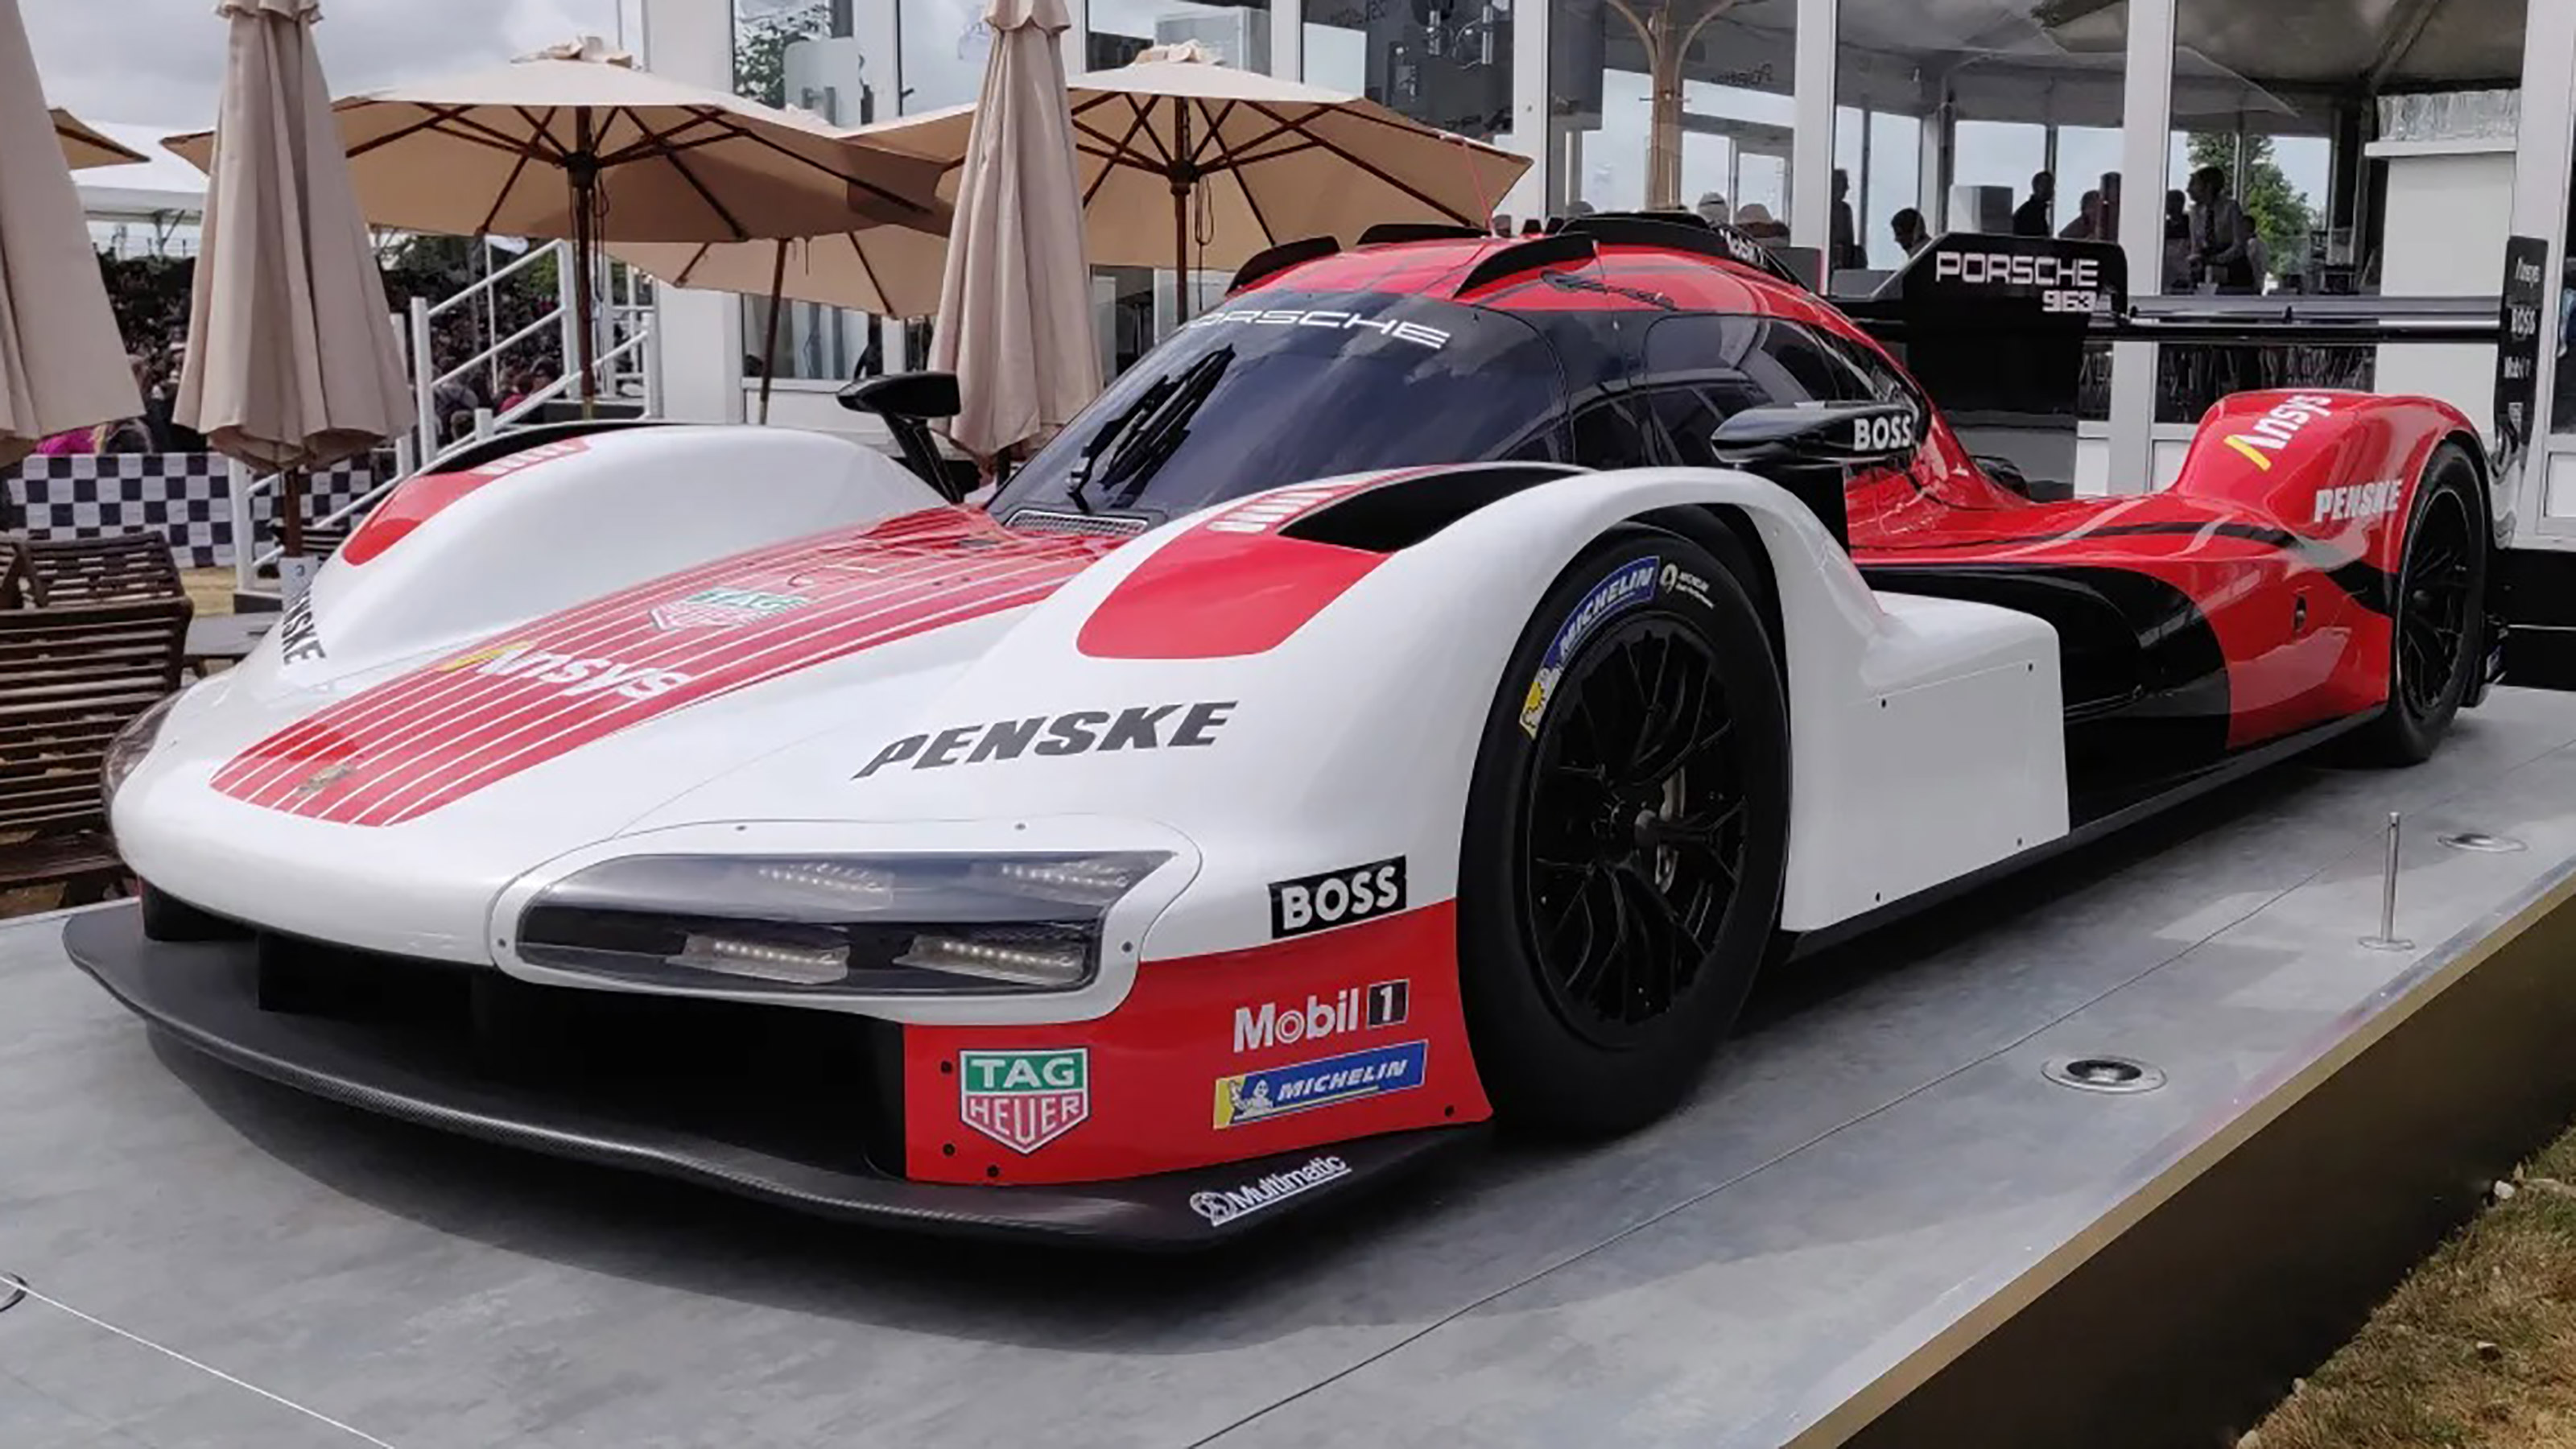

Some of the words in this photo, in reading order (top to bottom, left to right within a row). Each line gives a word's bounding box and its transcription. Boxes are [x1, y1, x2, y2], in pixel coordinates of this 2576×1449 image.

[1936, 251, 2099, 286] PORSCHE
[2042, 290, 2097, 312] 963
[1854, 415, 1912, 451] BOSS
[2224, 394, 2333, 471] Ansys
[2314, 481, 2403, 522] PENSKE
[1558, 566, 1656, 658] MICHELIN
[850, 700, 1238, 781] PENSKE
[1282, 865, 1398, 930] BOSS
[1233, 988, 1359, 1053] Mobil
[971, 1058, 1075, 1088] TAG
[1278, 1059, 1408, 1100] MICHELIN
[969, 1096, 1080, 1144] HEUER
[1225, 1155, 1347, 1208] Multimatic
